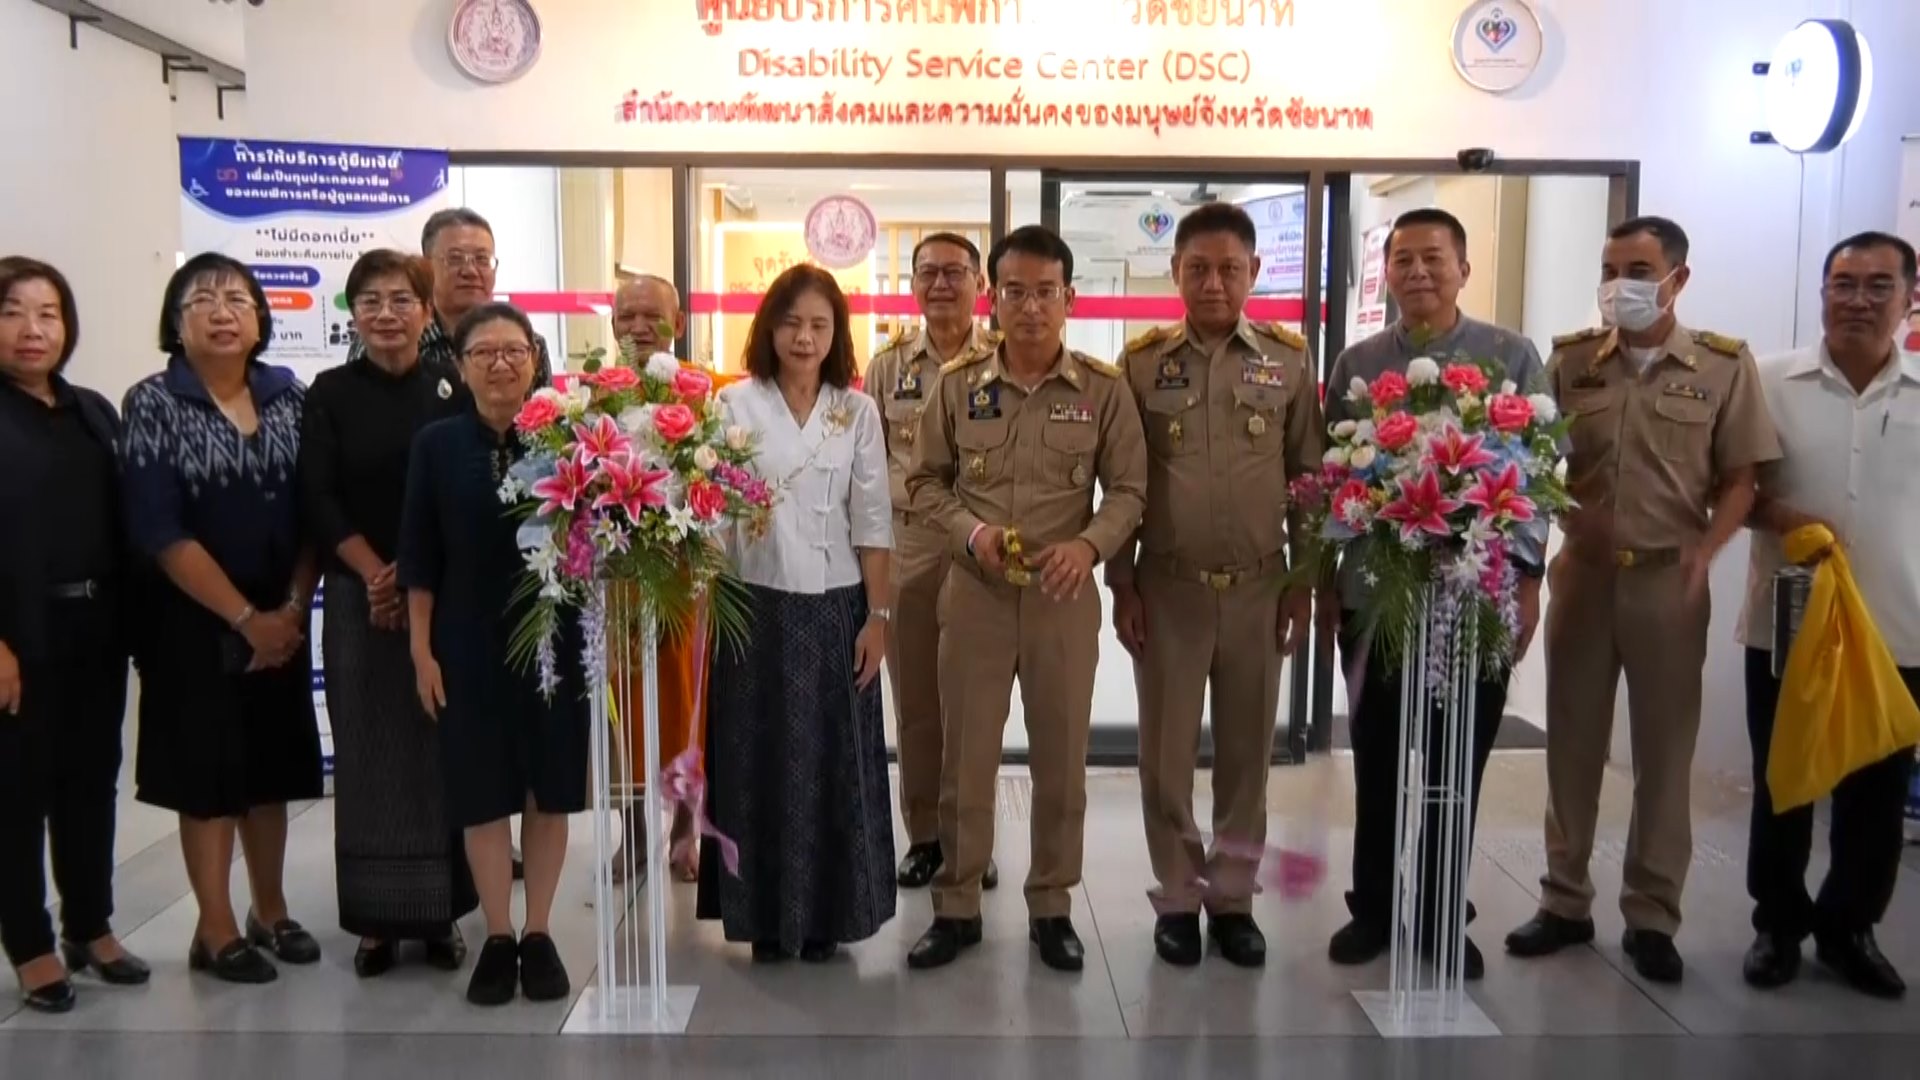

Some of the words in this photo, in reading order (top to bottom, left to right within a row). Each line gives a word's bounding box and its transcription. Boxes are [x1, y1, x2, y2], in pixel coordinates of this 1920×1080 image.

[738, 48, 893, 85] Disability
[906, 48, 1023, 79] Service
[1037, 51, 1149, 81] Center
[1162, 49, 1251, 84] (DSC)
